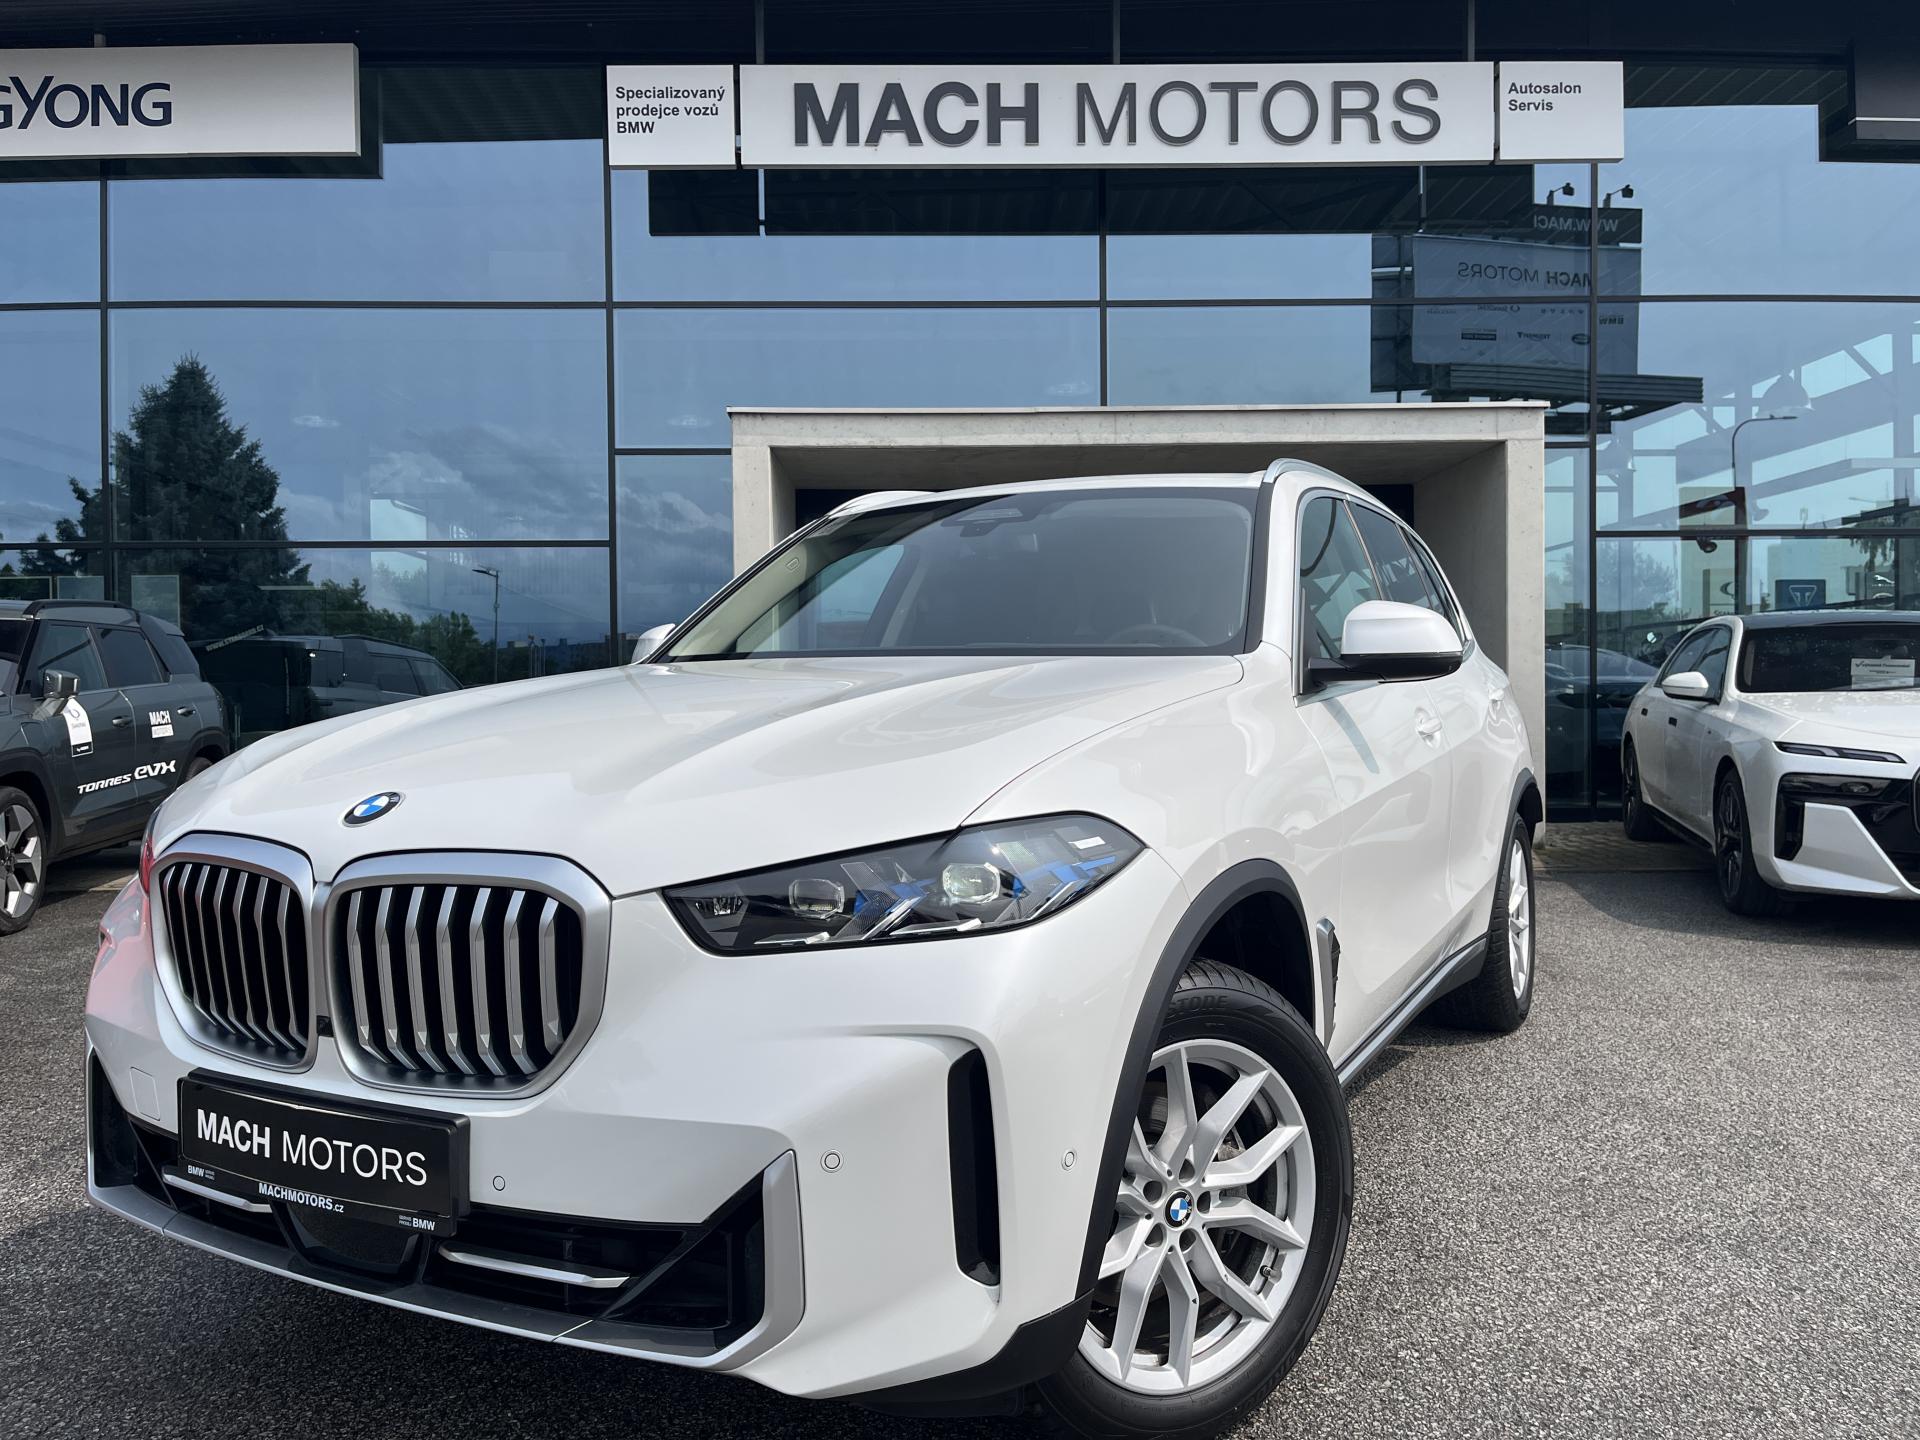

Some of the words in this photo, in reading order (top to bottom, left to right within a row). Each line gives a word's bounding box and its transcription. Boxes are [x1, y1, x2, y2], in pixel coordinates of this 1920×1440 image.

[615, 86, 725, 101] Specializovaný
[1508, 82, 1582, 94] Autosalon
[616, 104, 680, 119] prodejce
[684, 103, 719, 116] vozů
[794, 81, 1039, 147] MACH
[1076, 78, 1441, 146] MOTORS
[1508, 99, 1553, 111] Servis
[616, 121, 655, 133] BMW
[149, 710, 171, 725] MACH
[78, 774, 132, 794] TORRES
[197, 1108, 271, 1158] MACH
[283, 1131, 427, 1186] MOTORS
[187, 1165, 205, 1177] BMW
[412, 1217, 436, 1231] BMW
